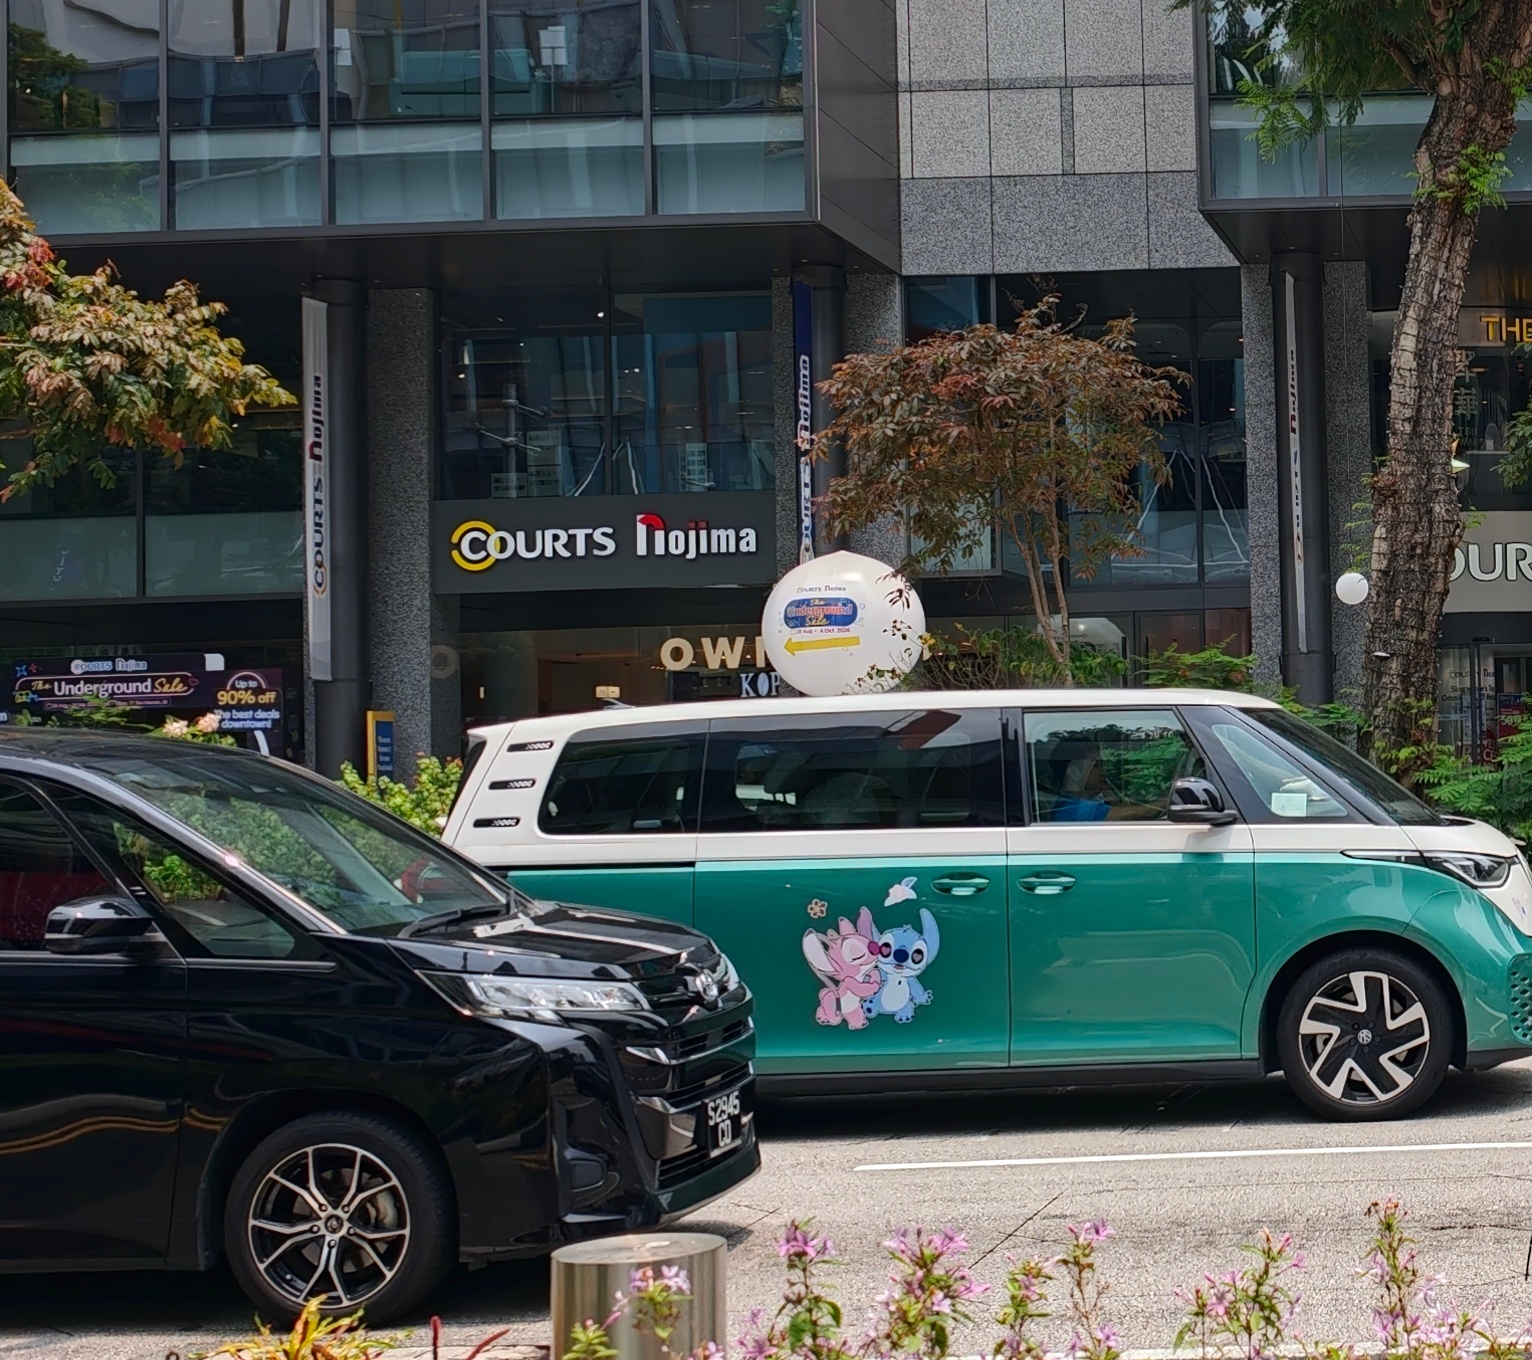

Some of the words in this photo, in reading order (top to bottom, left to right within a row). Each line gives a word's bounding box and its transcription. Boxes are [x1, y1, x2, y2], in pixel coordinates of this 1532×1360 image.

[452, 522, 617, 569] COURTS
[71, 660, 113, 674] COURTS
[54, 678, 152, 698] Underground
[154, 677, 188, 693] Sale
[235, 680, 247, 688] Up
[217, 690, 255, 705] 90%
[258, 692, 276, 703] off
[232, 709, 254, 719] best
[254, 709, 280, 719] deals
[221, 720, 272, 729] downtown!
[708, 1091, 740, 1126] S2945
[718, 1119, 732, 1147] CD
